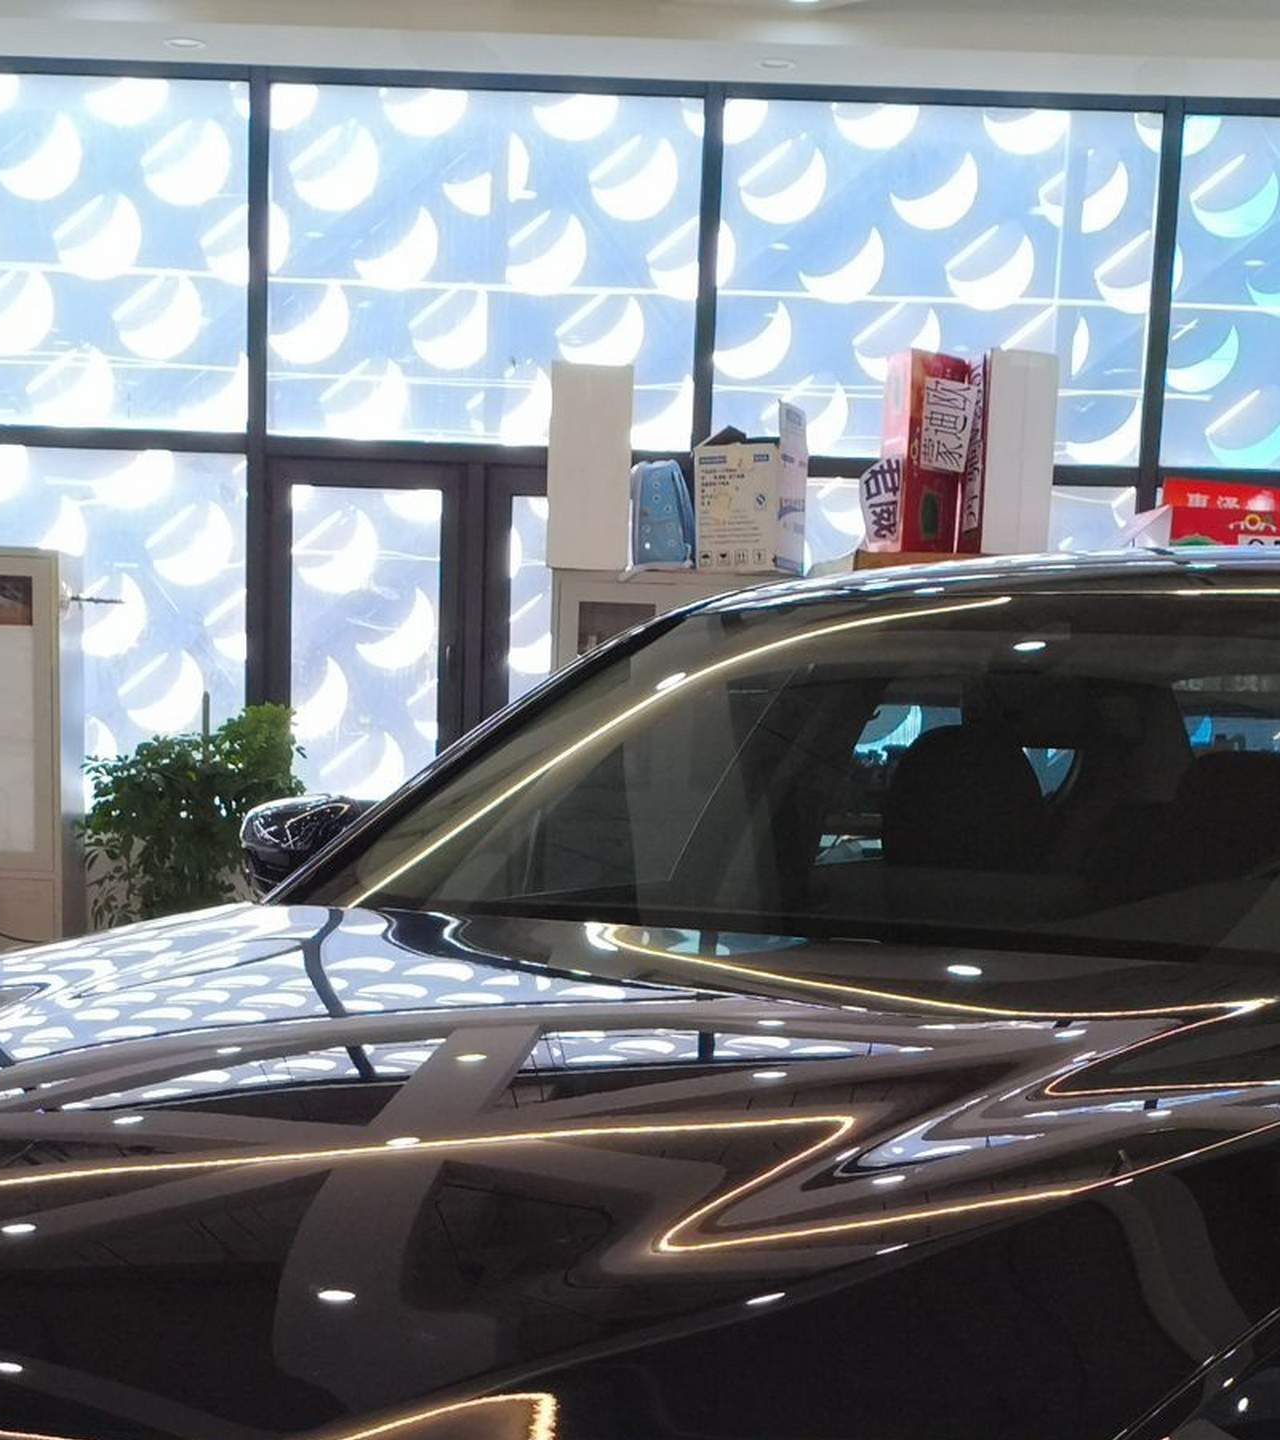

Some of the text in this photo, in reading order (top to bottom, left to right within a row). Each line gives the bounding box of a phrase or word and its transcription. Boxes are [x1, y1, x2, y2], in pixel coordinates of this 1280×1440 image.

[922, 379, 973, 469] 蒙迪欧
[863, 458, 902, 540] 君威
